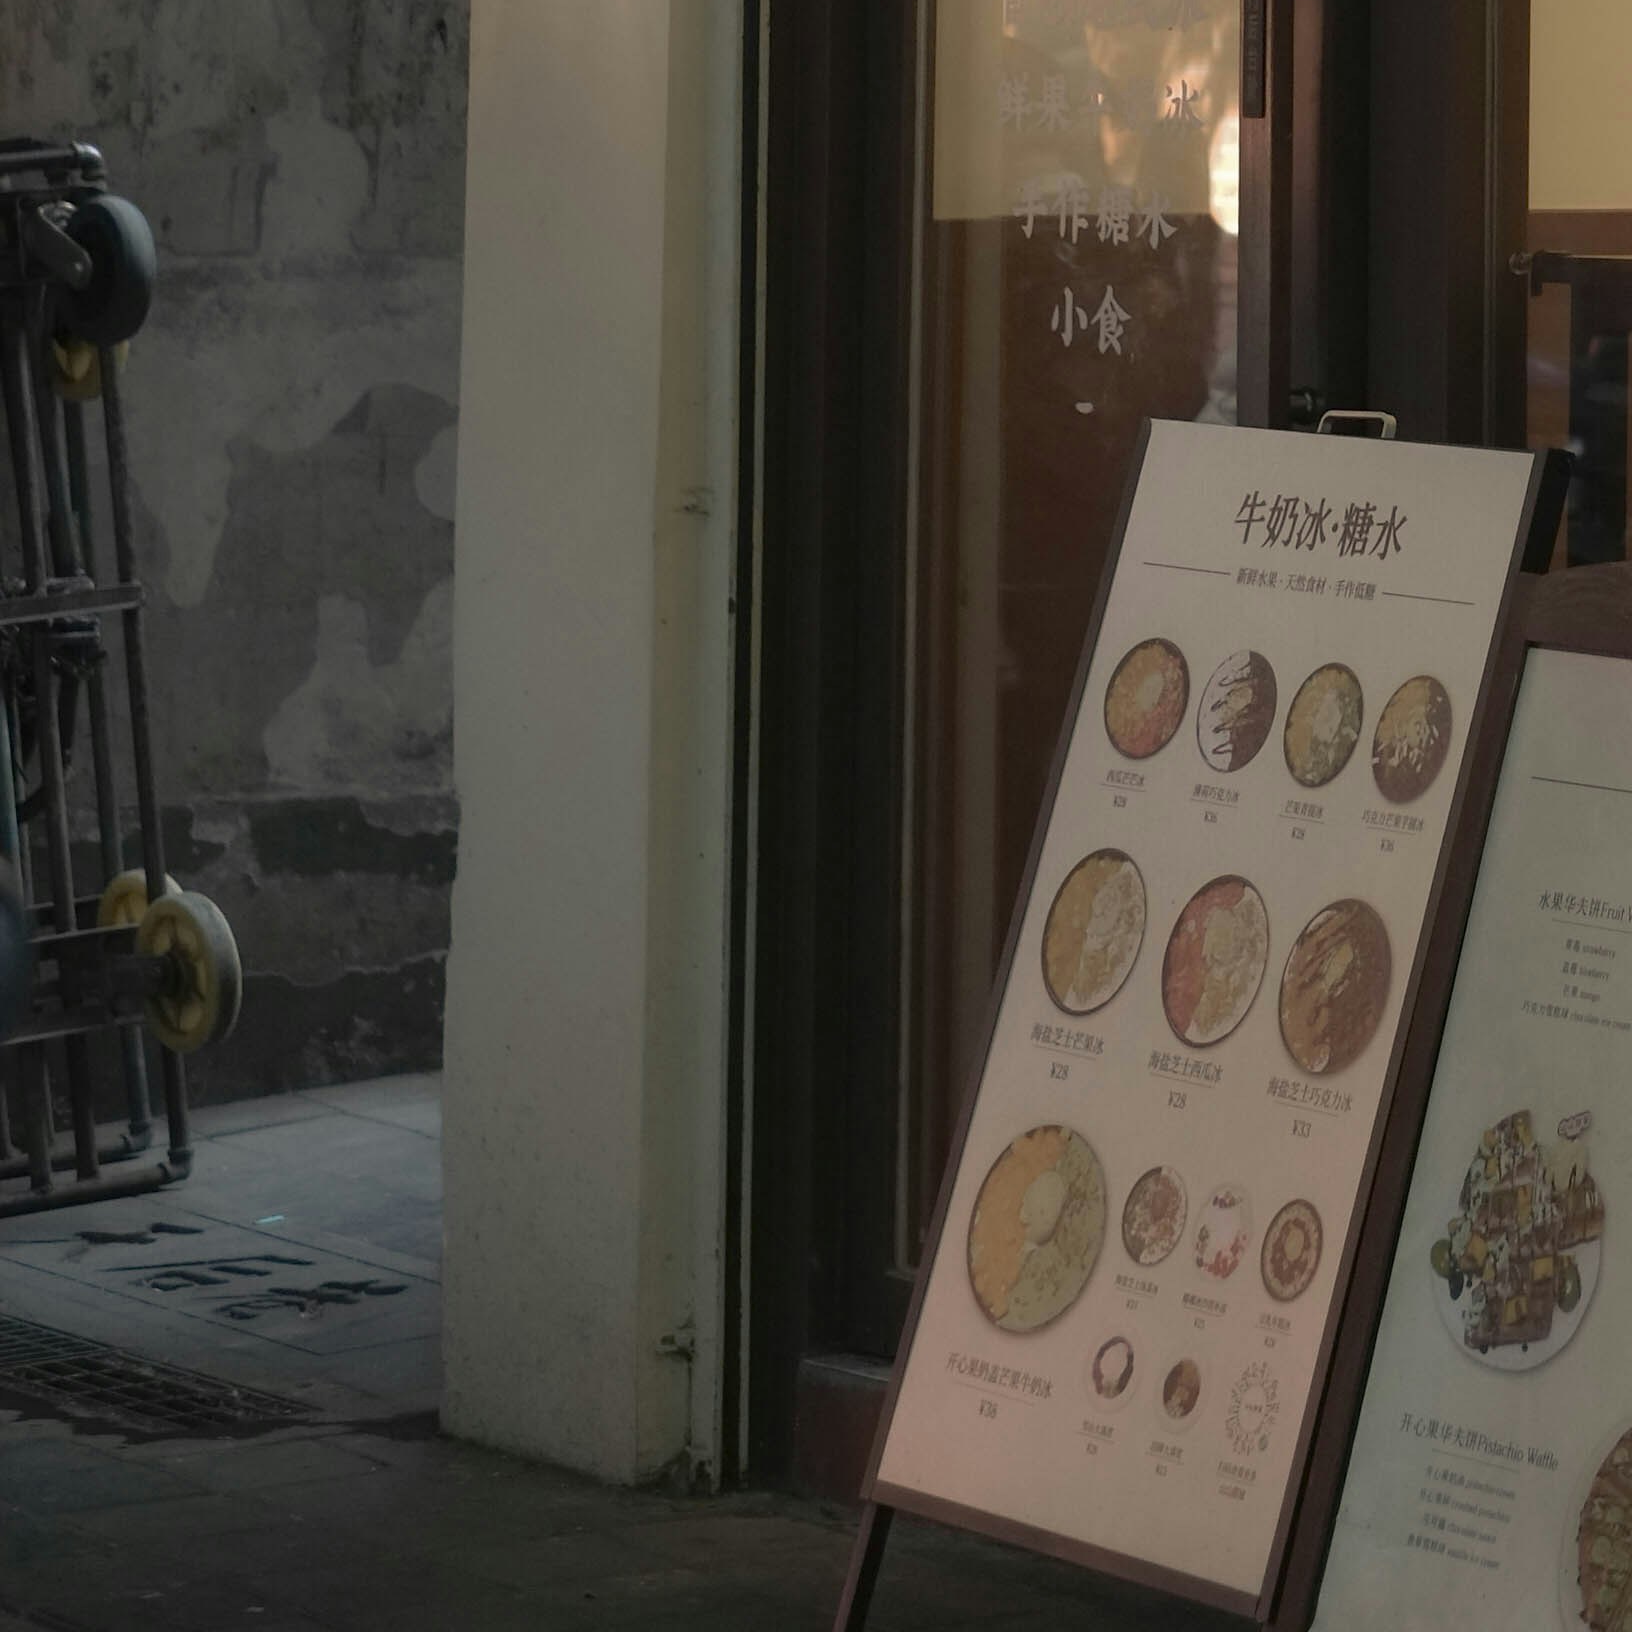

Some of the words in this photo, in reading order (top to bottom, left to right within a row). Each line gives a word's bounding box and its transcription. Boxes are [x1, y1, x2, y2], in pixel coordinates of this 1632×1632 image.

[1013, 183, 1178, 249] 手作糖水
[1051, 285, 1132, 355] 小食
